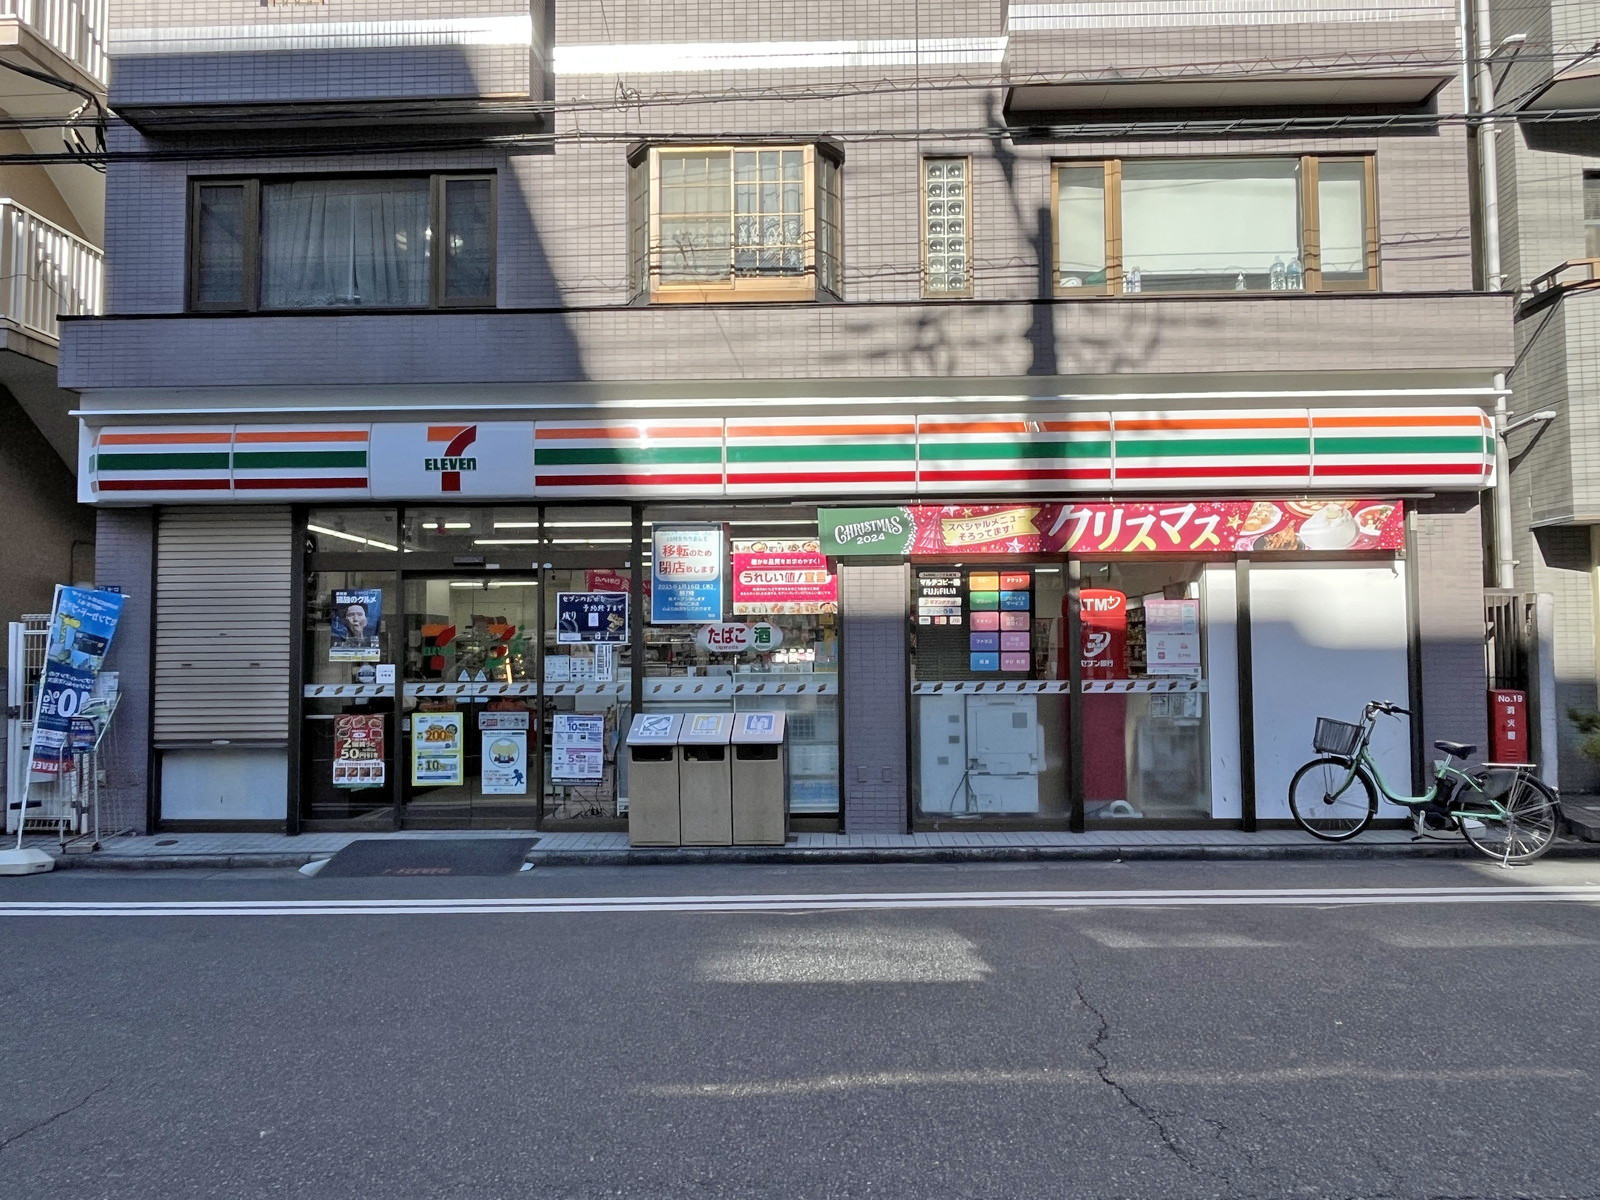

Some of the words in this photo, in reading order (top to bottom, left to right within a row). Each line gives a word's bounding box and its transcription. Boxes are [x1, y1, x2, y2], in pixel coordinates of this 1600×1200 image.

[834, 516, 903, 544] CHRISTMAS
[948, 514, 1026, 532] スペシャルメニュー
[1048, 503, 1221, 552] クリスマス
[856, 533, 886, 545] 2024
[959, 525, 1014, 541] そろってます！
[662, 544, 712, 557] 移転のため
[659, 561, 715, 575] 閉店致します
[562, 611, 577, 621] 残り
[708, 627, 746, 644] たばこ
[754, 627, 771, 644] 酒
[1498, 695, 1523, 703] No.19
